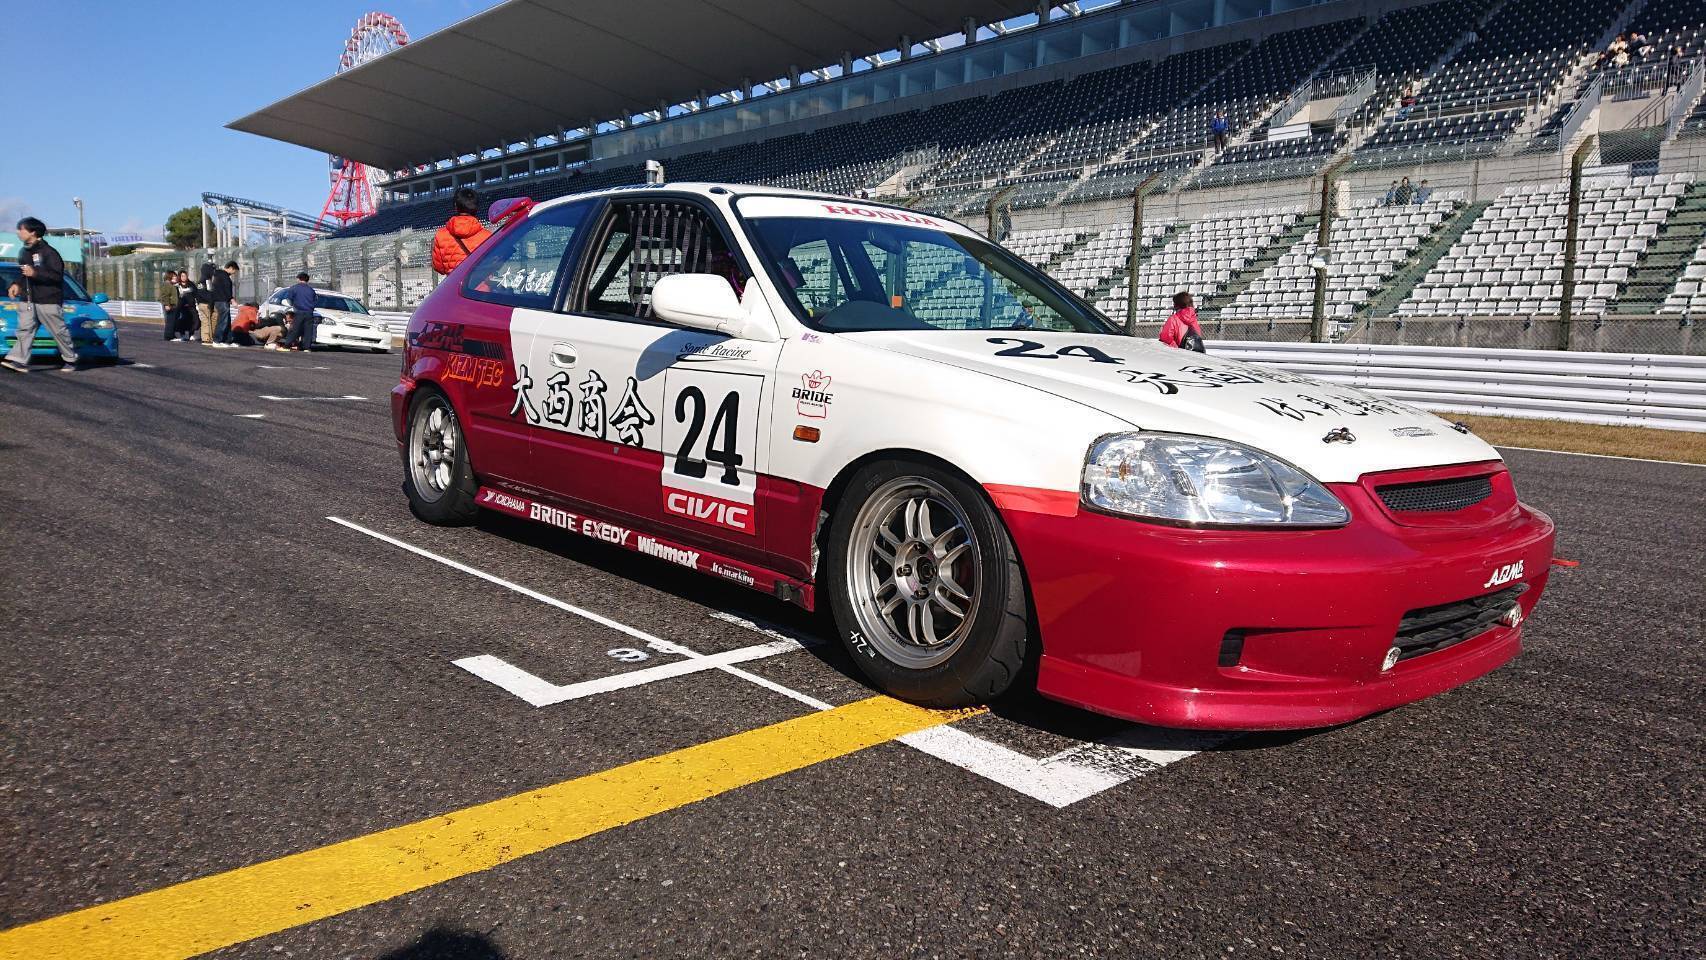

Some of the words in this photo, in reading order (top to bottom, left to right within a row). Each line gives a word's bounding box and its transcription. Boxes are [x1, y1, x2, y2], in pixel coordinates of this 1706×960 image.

[821, 204, 943, 228] HONDA
[680, 342, 710, 355] Sonic
[711, 344, 751, 360] Racing
[986, 337, 1125, 365] 24
[510, 364, 655, 448] 大西商会
[791, 387, 834, 406] BRIDE
[673, 385, 743, 487] 24
[494, 493, 525, 512] YOKOHAMA
[530, 502, 577, 532] BRIDE
[582, 519, 631, 546] EXEDY
[667, 492, 749, 529] CIVIC
